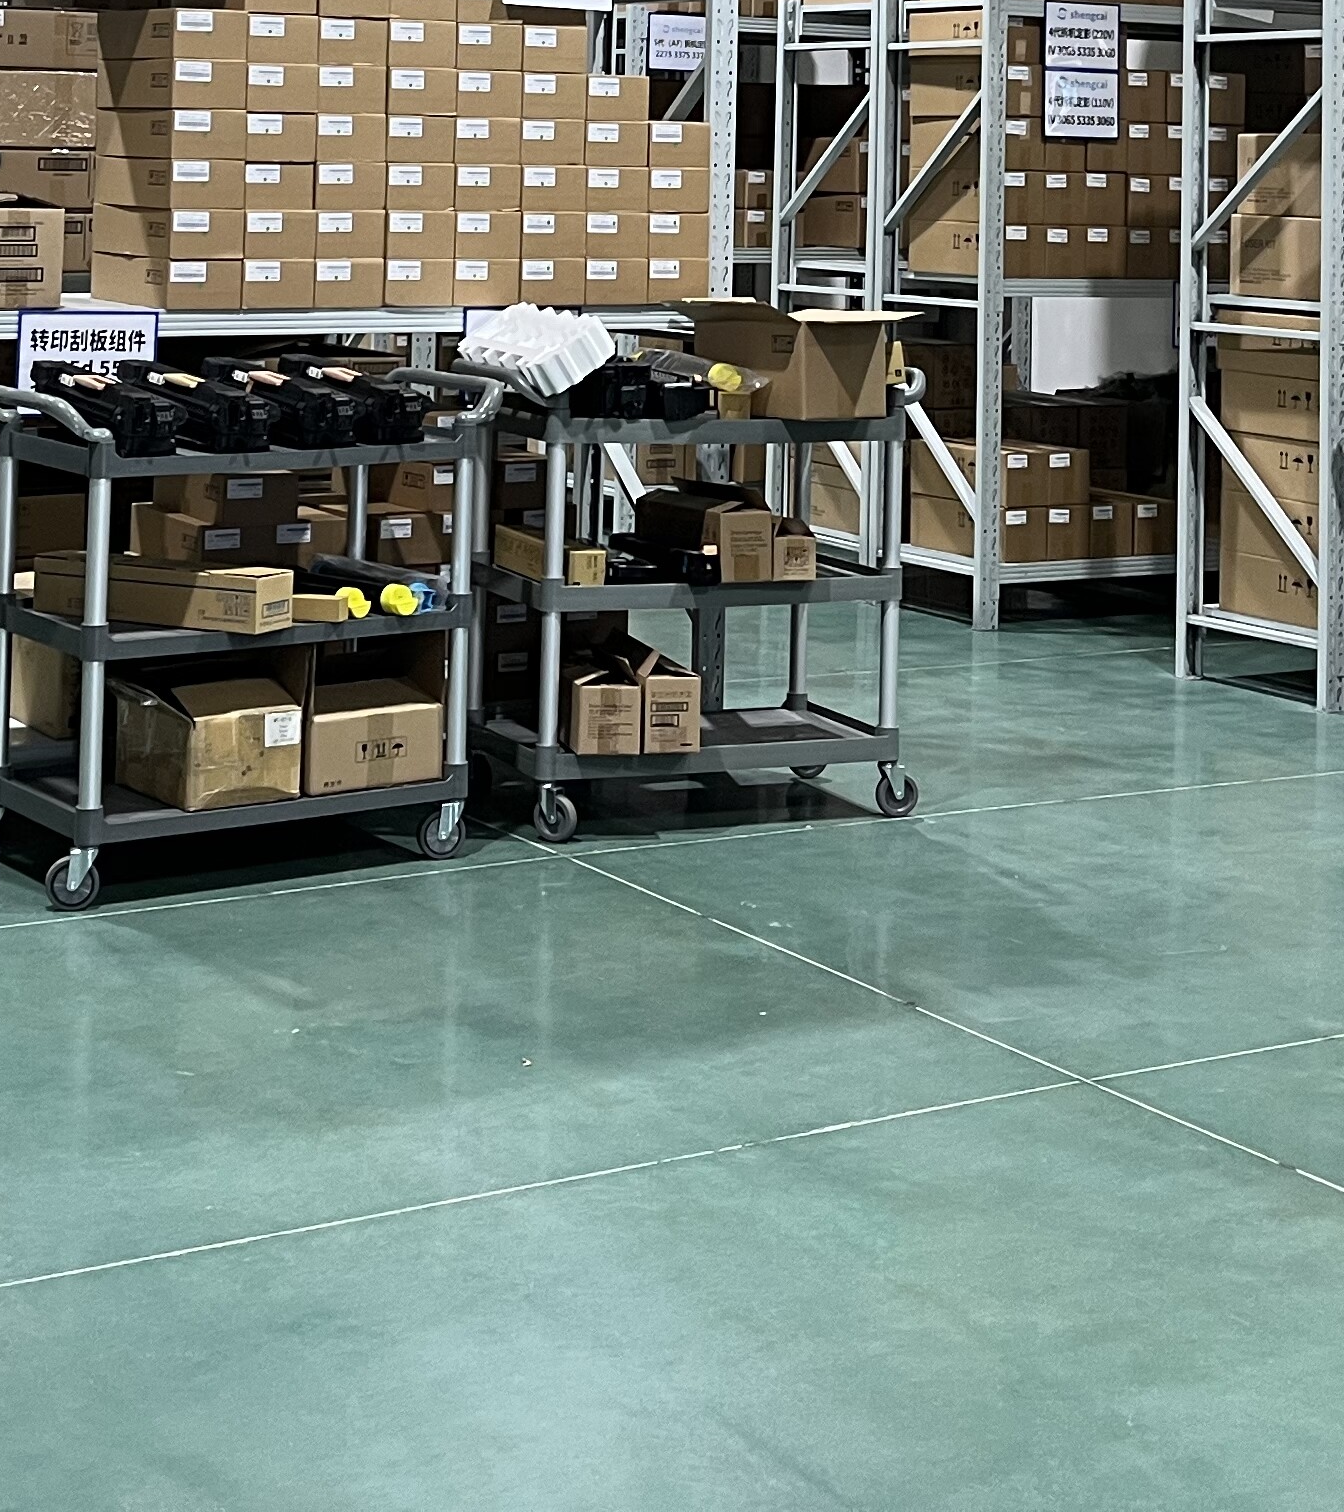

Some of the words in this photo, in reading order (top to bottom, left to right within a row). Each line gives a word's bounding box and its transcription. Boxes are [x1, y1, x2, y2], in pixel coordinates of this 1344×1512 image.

[30, 328, 147, 353] 转印刮板组件
